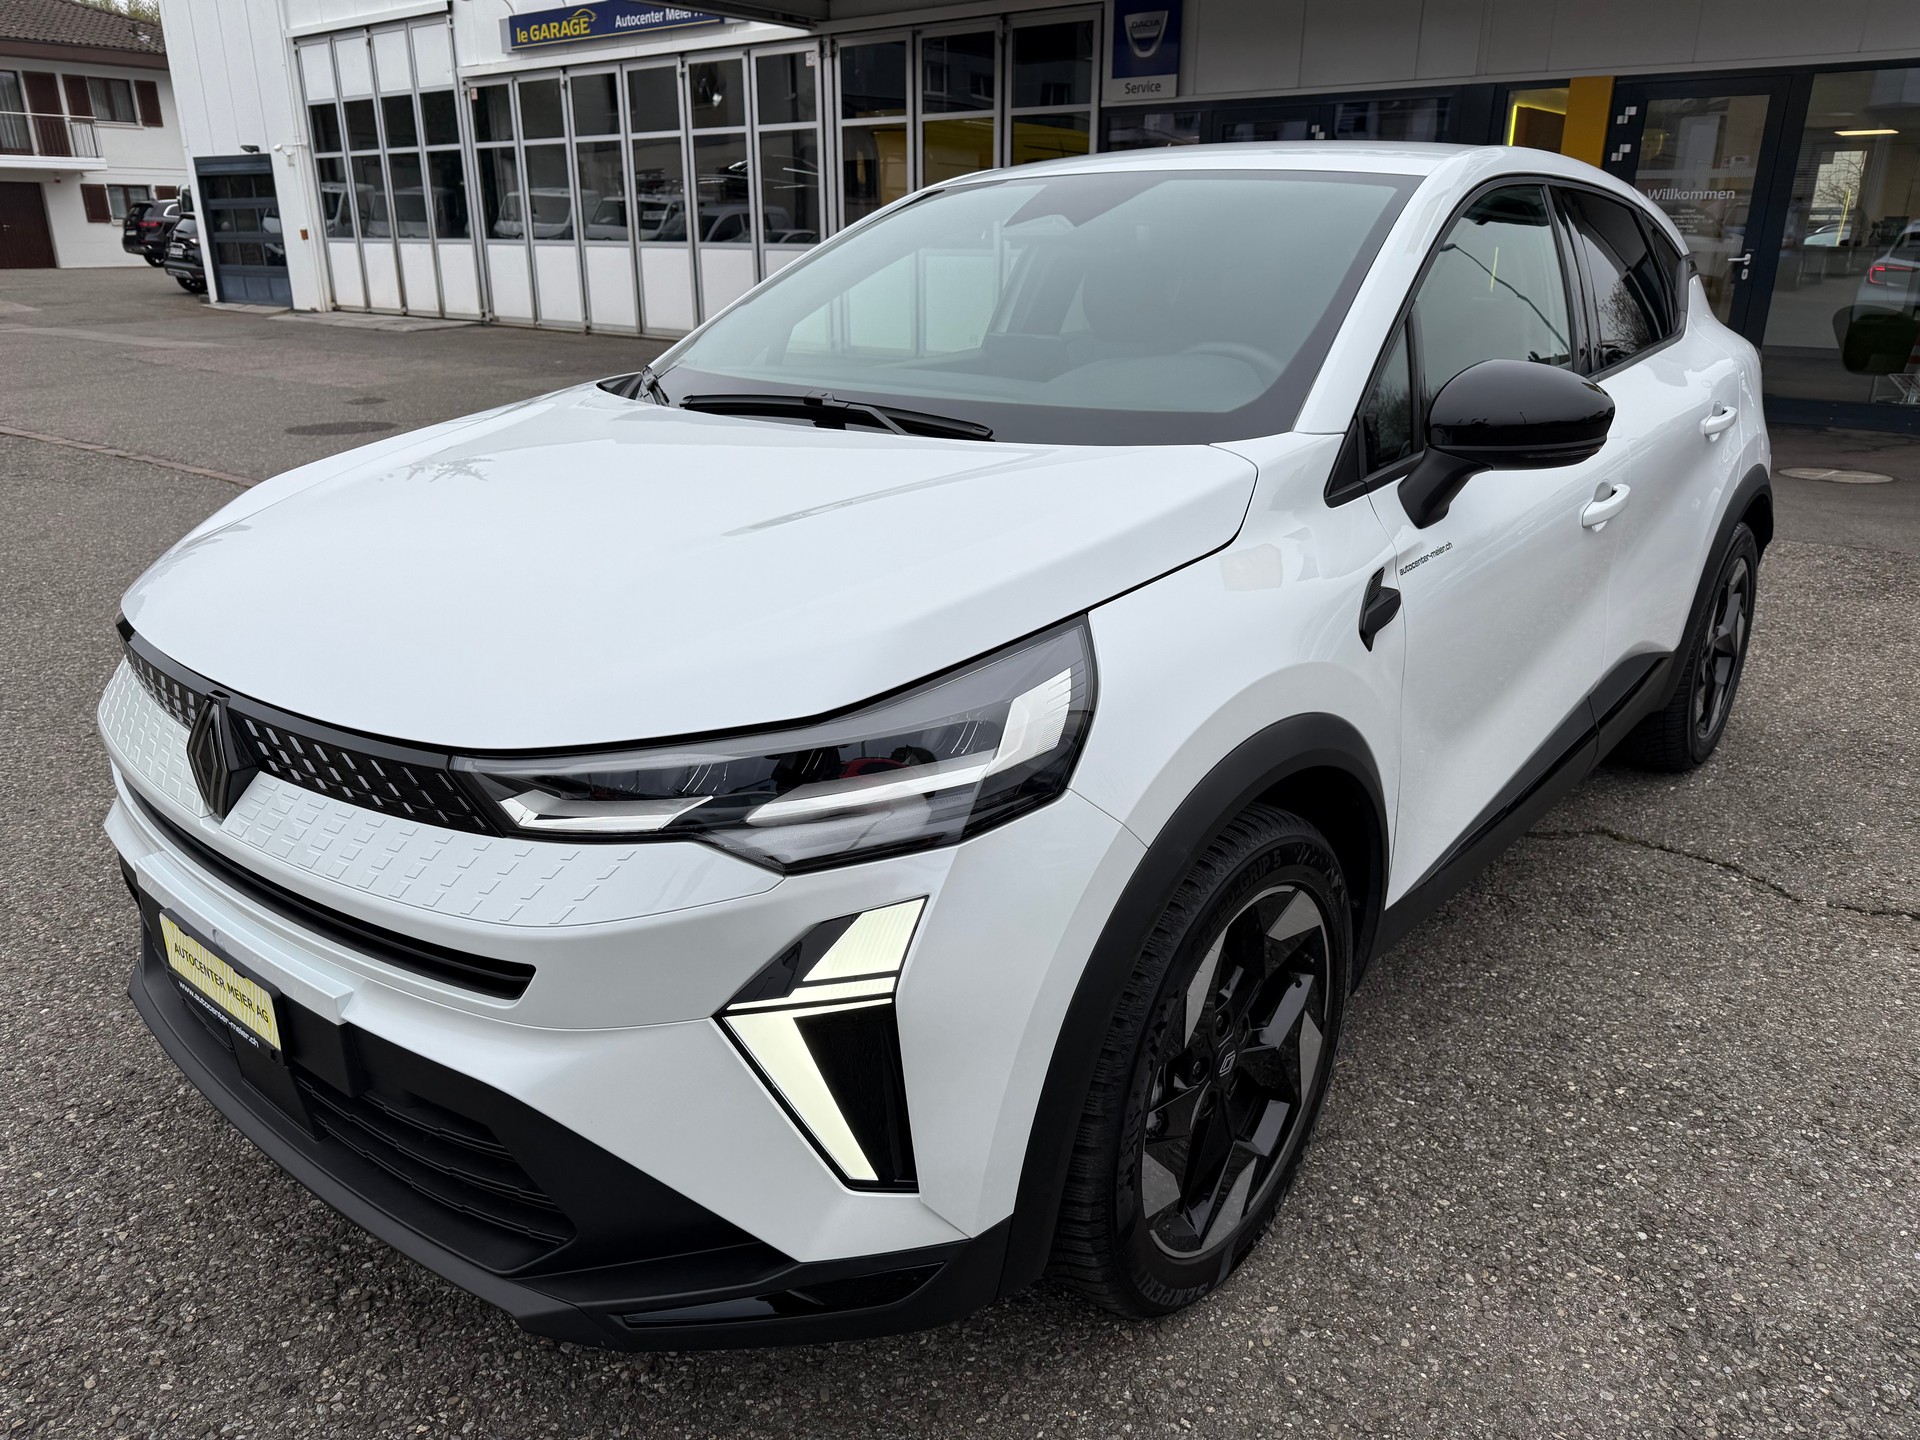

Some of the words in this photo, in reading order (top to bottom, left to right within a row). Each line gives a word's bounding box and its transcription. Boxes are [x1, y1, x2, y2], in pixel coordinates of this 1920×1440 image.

[516, 27, 528, 43] le
[529, 17, 591, 41] GARAGE
[615, 11, 664, 28] Autocenter
[1131, 19, 1160, 29] DACIA
[1124, 81, 1161, 94] Service
[1647, 188, 1735, 200] Willkommen
[1399, 541, 1453, 576] autocenter-meier.ch
[1272, 848, 1282, 869] 5
[174, 942, 226, 991] AUTOCENTER
[227, 983, 255, 1012] MEIER
[256, 1005, 269, 1023] AG
[178, 980, 260, 1048] www.autocenter-meier.ch
